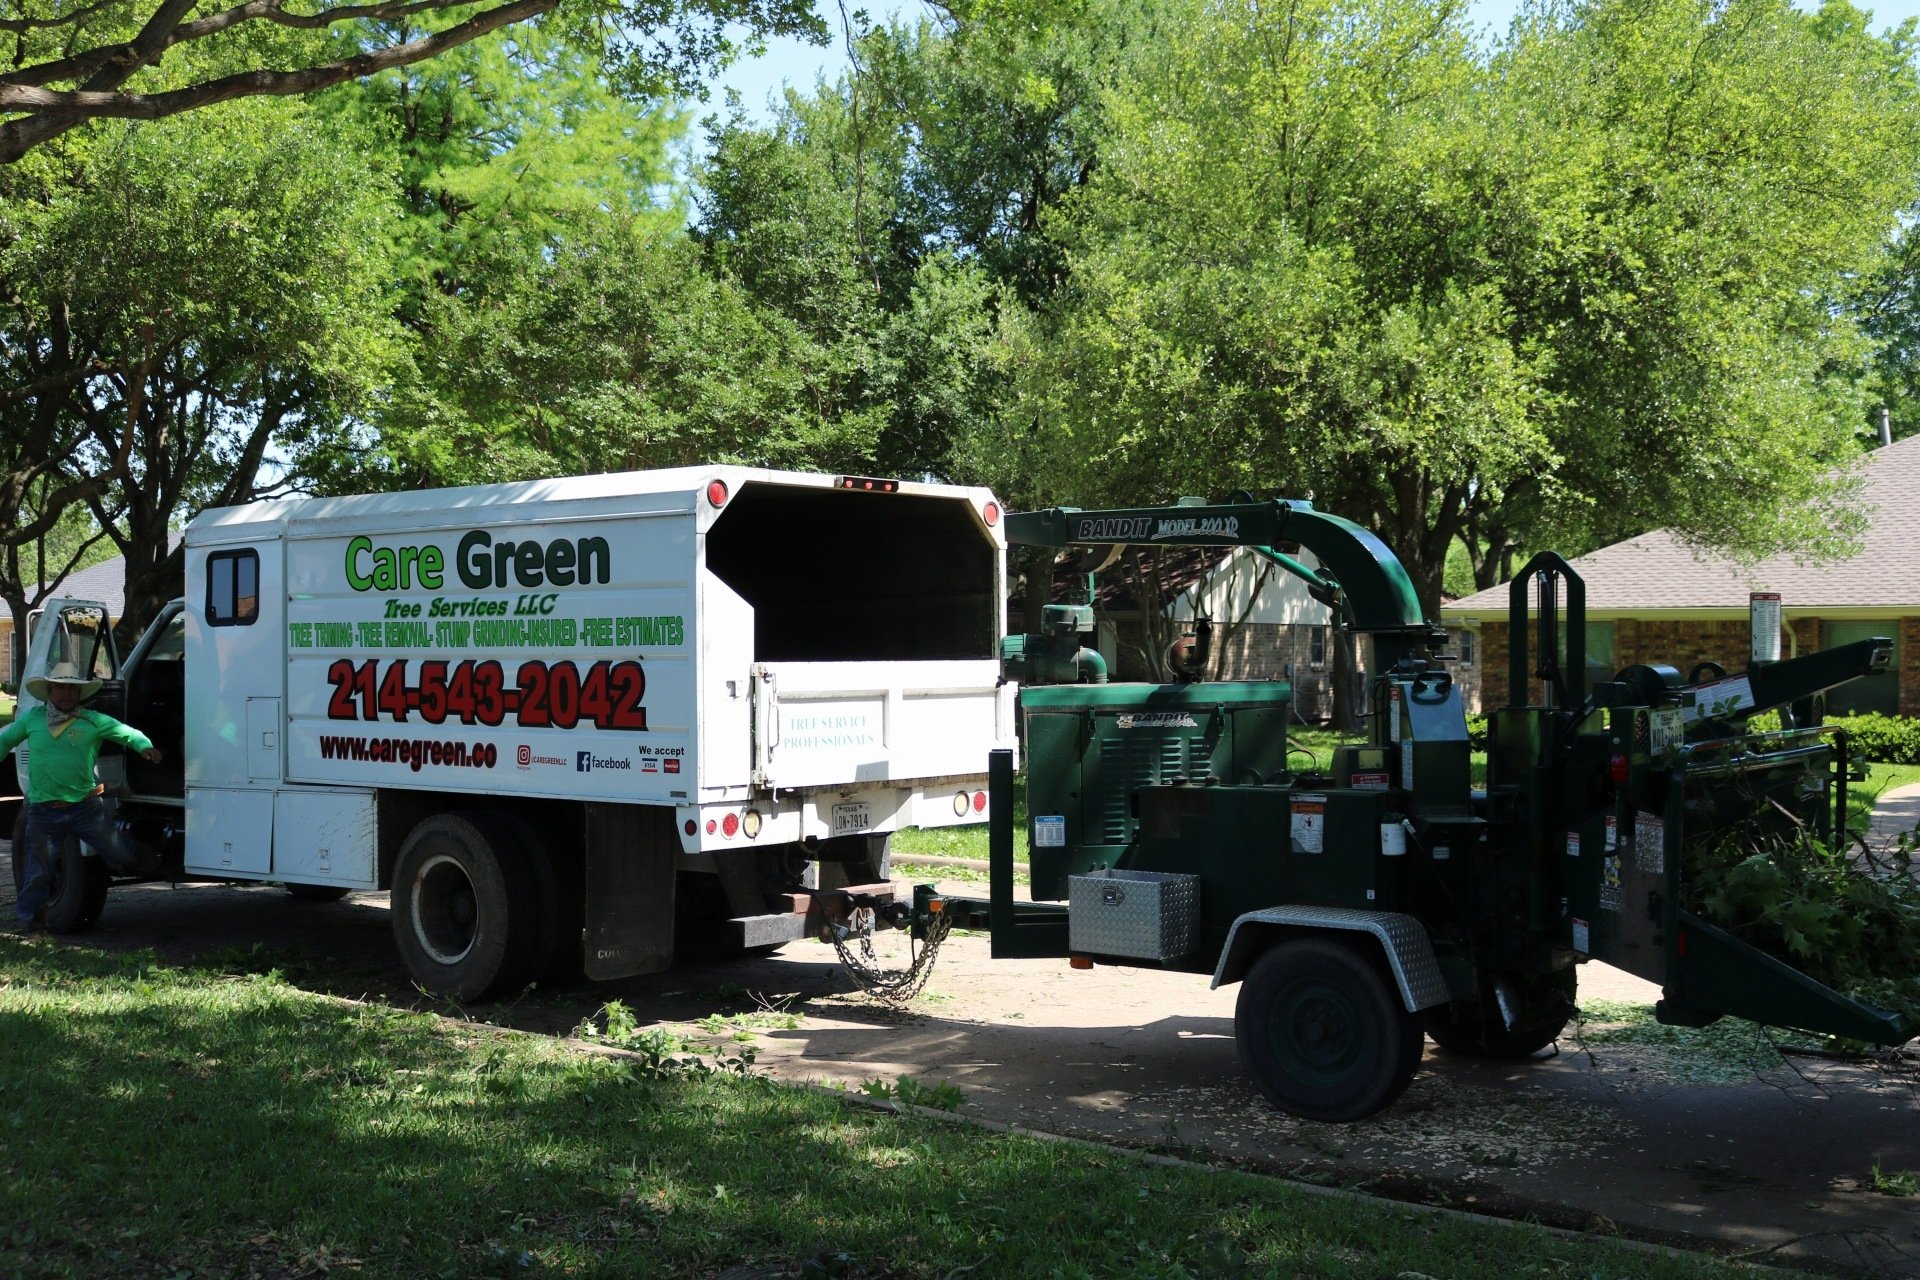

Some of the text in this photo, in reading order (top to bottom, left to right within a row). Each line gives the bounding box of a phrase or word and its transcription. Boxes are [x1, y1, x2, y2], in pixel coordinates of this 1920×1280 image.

[1079, 518, 1152, 540] BANDIT
[1157, 518, 1196, 536] MODEL
[1200, 517, 1222, 536] 200
[345, 529, 611, 592] Care Green
[384, 593, 560, 619] Tree Services LLC
[289, 623, 313, 648] TREE
[435, 619, 471, 648] STUMP
[616, 616, 684, 646] ESTIMATES
[327, 658, 649, 732] 214-543-2042
[789, 715, 869, 731] TREE SERVICE
[1132, 712, 1190, 722] BANDIT
[639, 745, 685, 757] We accept
[784, 733, 876, 750] PROFESSIONALS
[319, 735, 498, 773] www.caregreen.co
[591, 756, 631, 770] facebook
